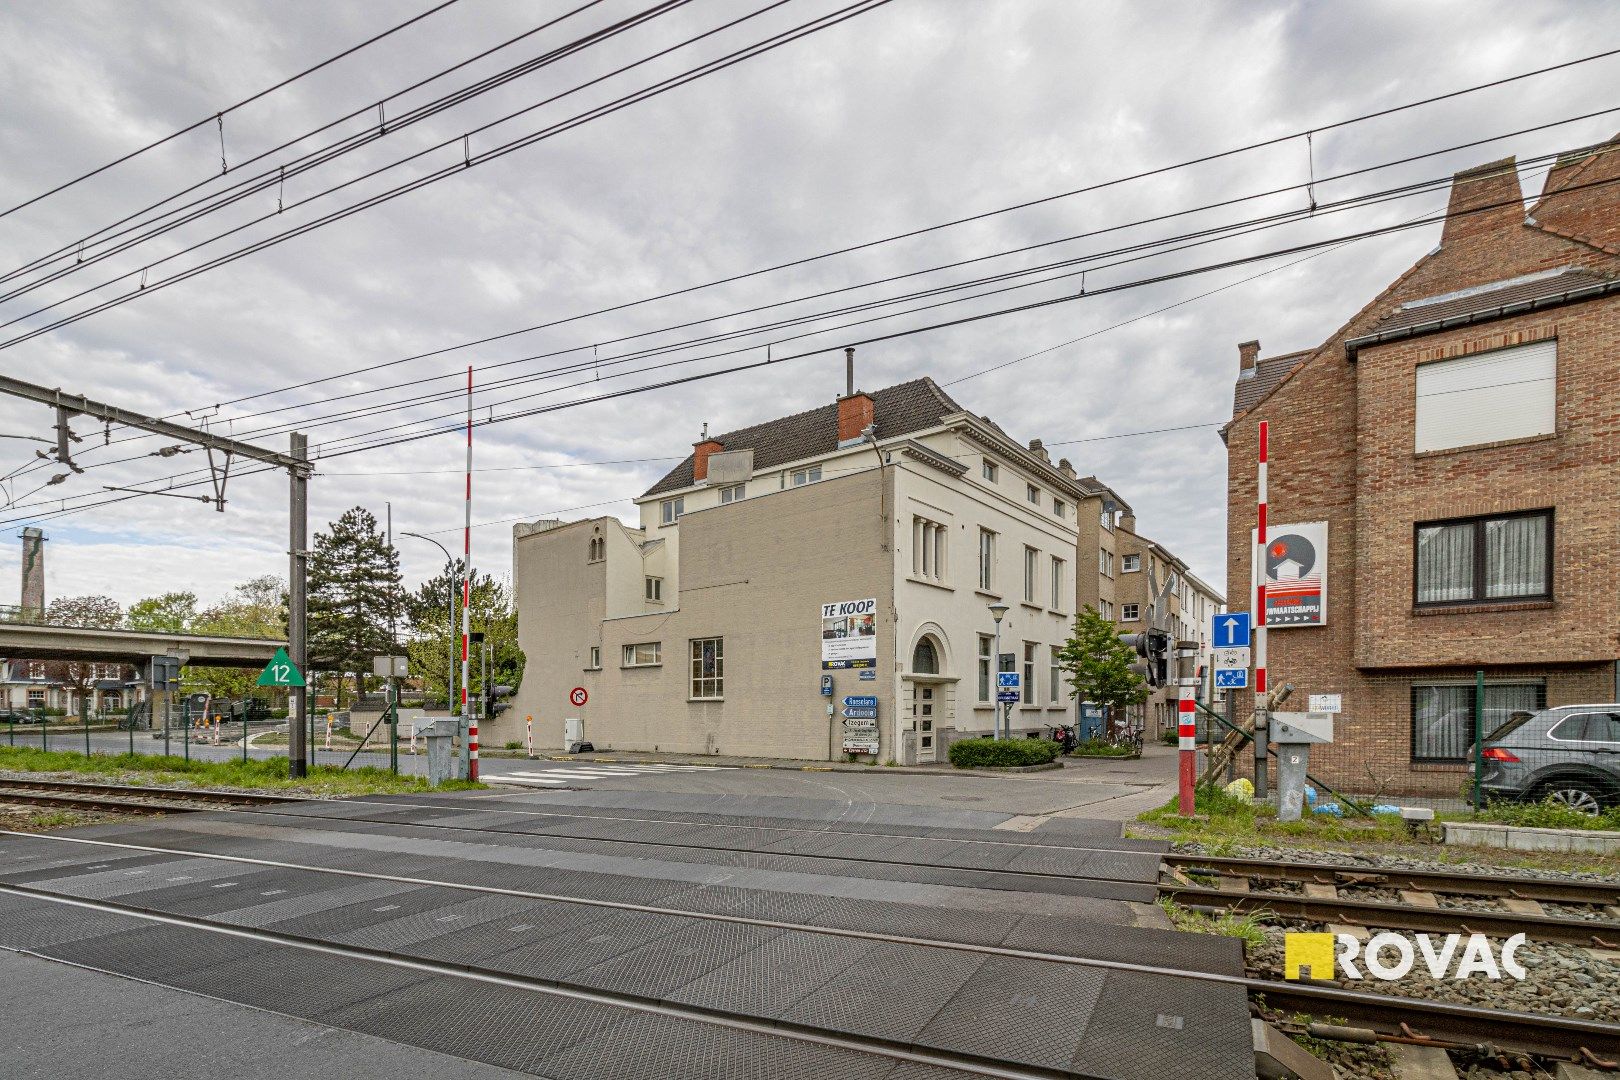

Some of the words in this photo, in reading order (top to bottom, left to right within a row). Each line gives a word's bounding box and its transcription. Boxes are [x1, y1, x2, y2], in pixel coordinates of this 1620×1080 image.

[823, 604, 836, 616] TE
[839, 600, 874, 615] KOOP
[271, 665, 290, 682] 12
[848, 709, 874, 717] Ardooie
